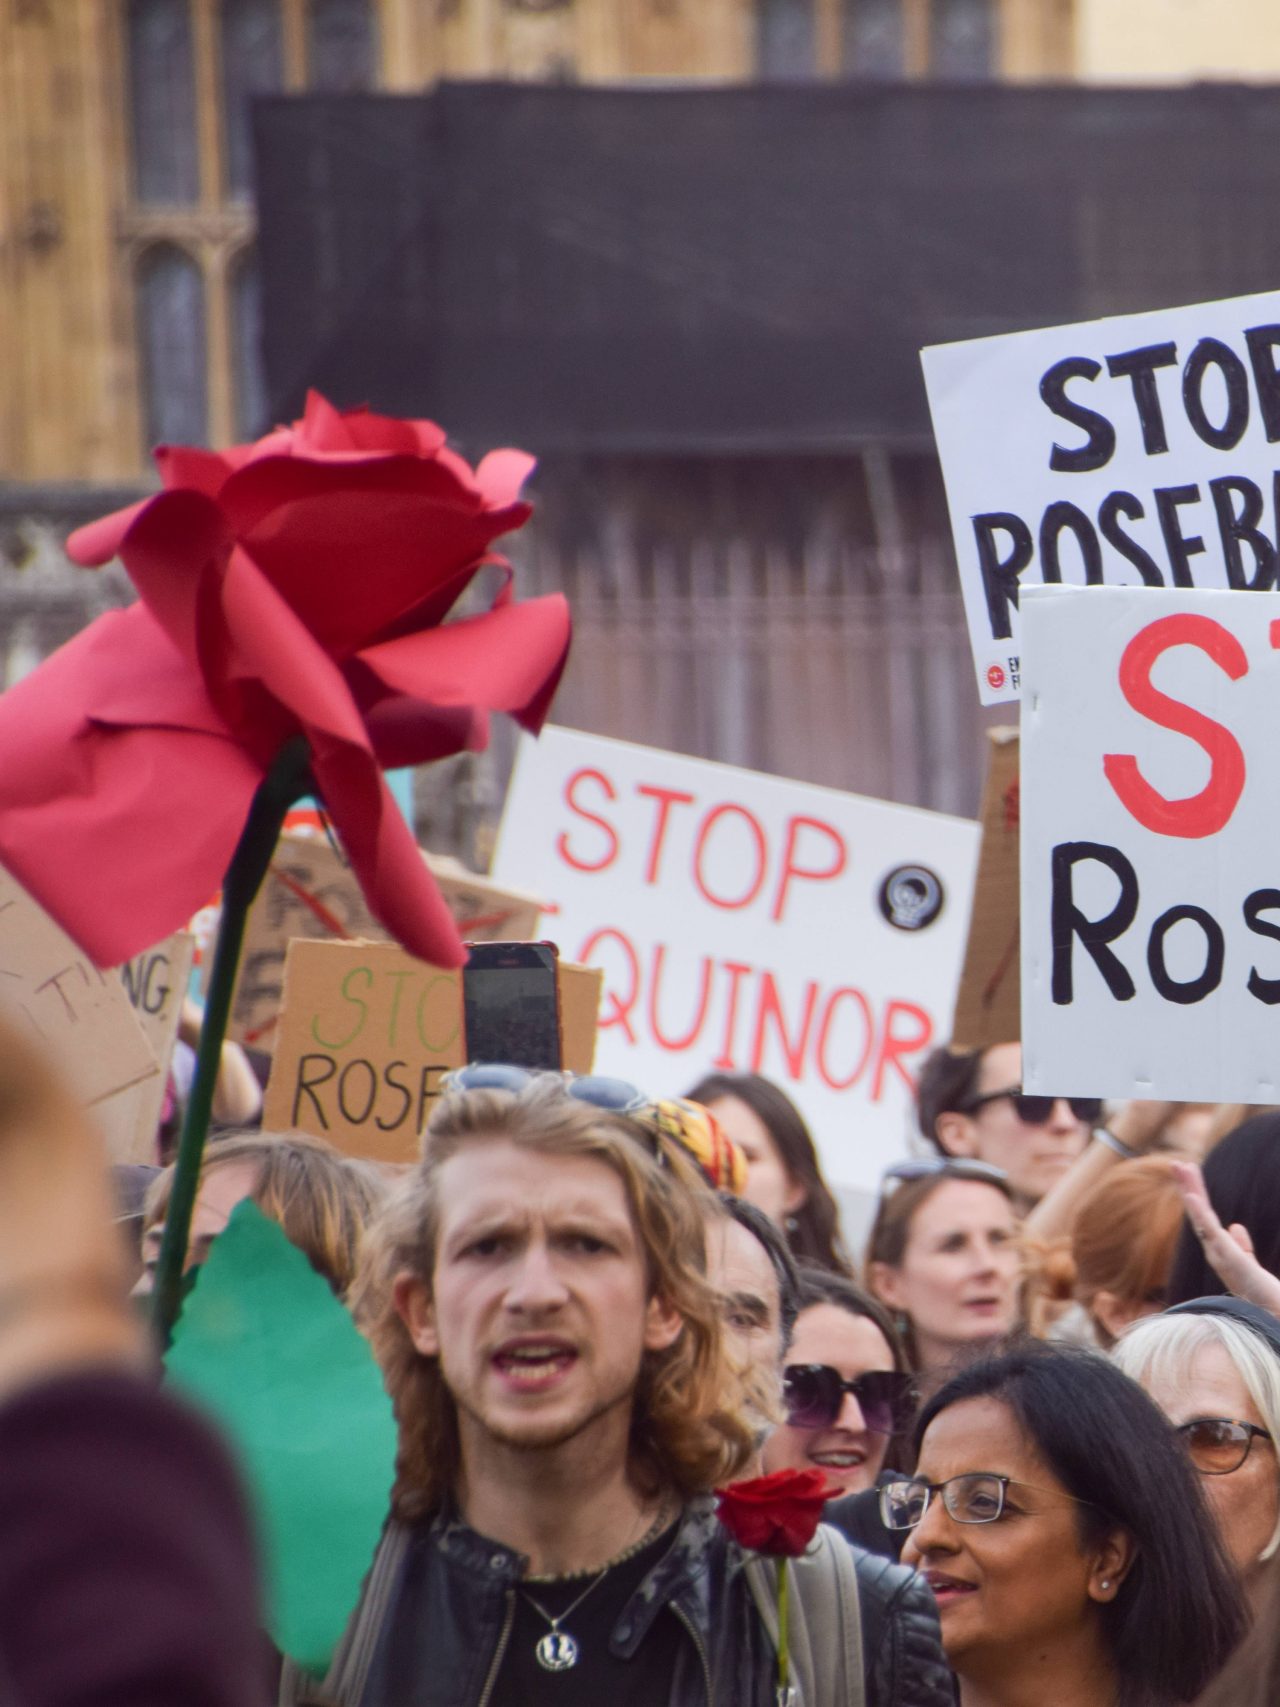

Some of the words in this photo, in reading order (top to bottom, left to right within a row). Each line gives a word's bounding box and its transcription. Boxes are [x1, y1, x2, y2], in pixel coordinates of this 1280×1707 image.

[556, 767, 847, 921] STOP
[312, 967, 459, 1053] STO
[538, 902, 934, 1103] QUINOR
